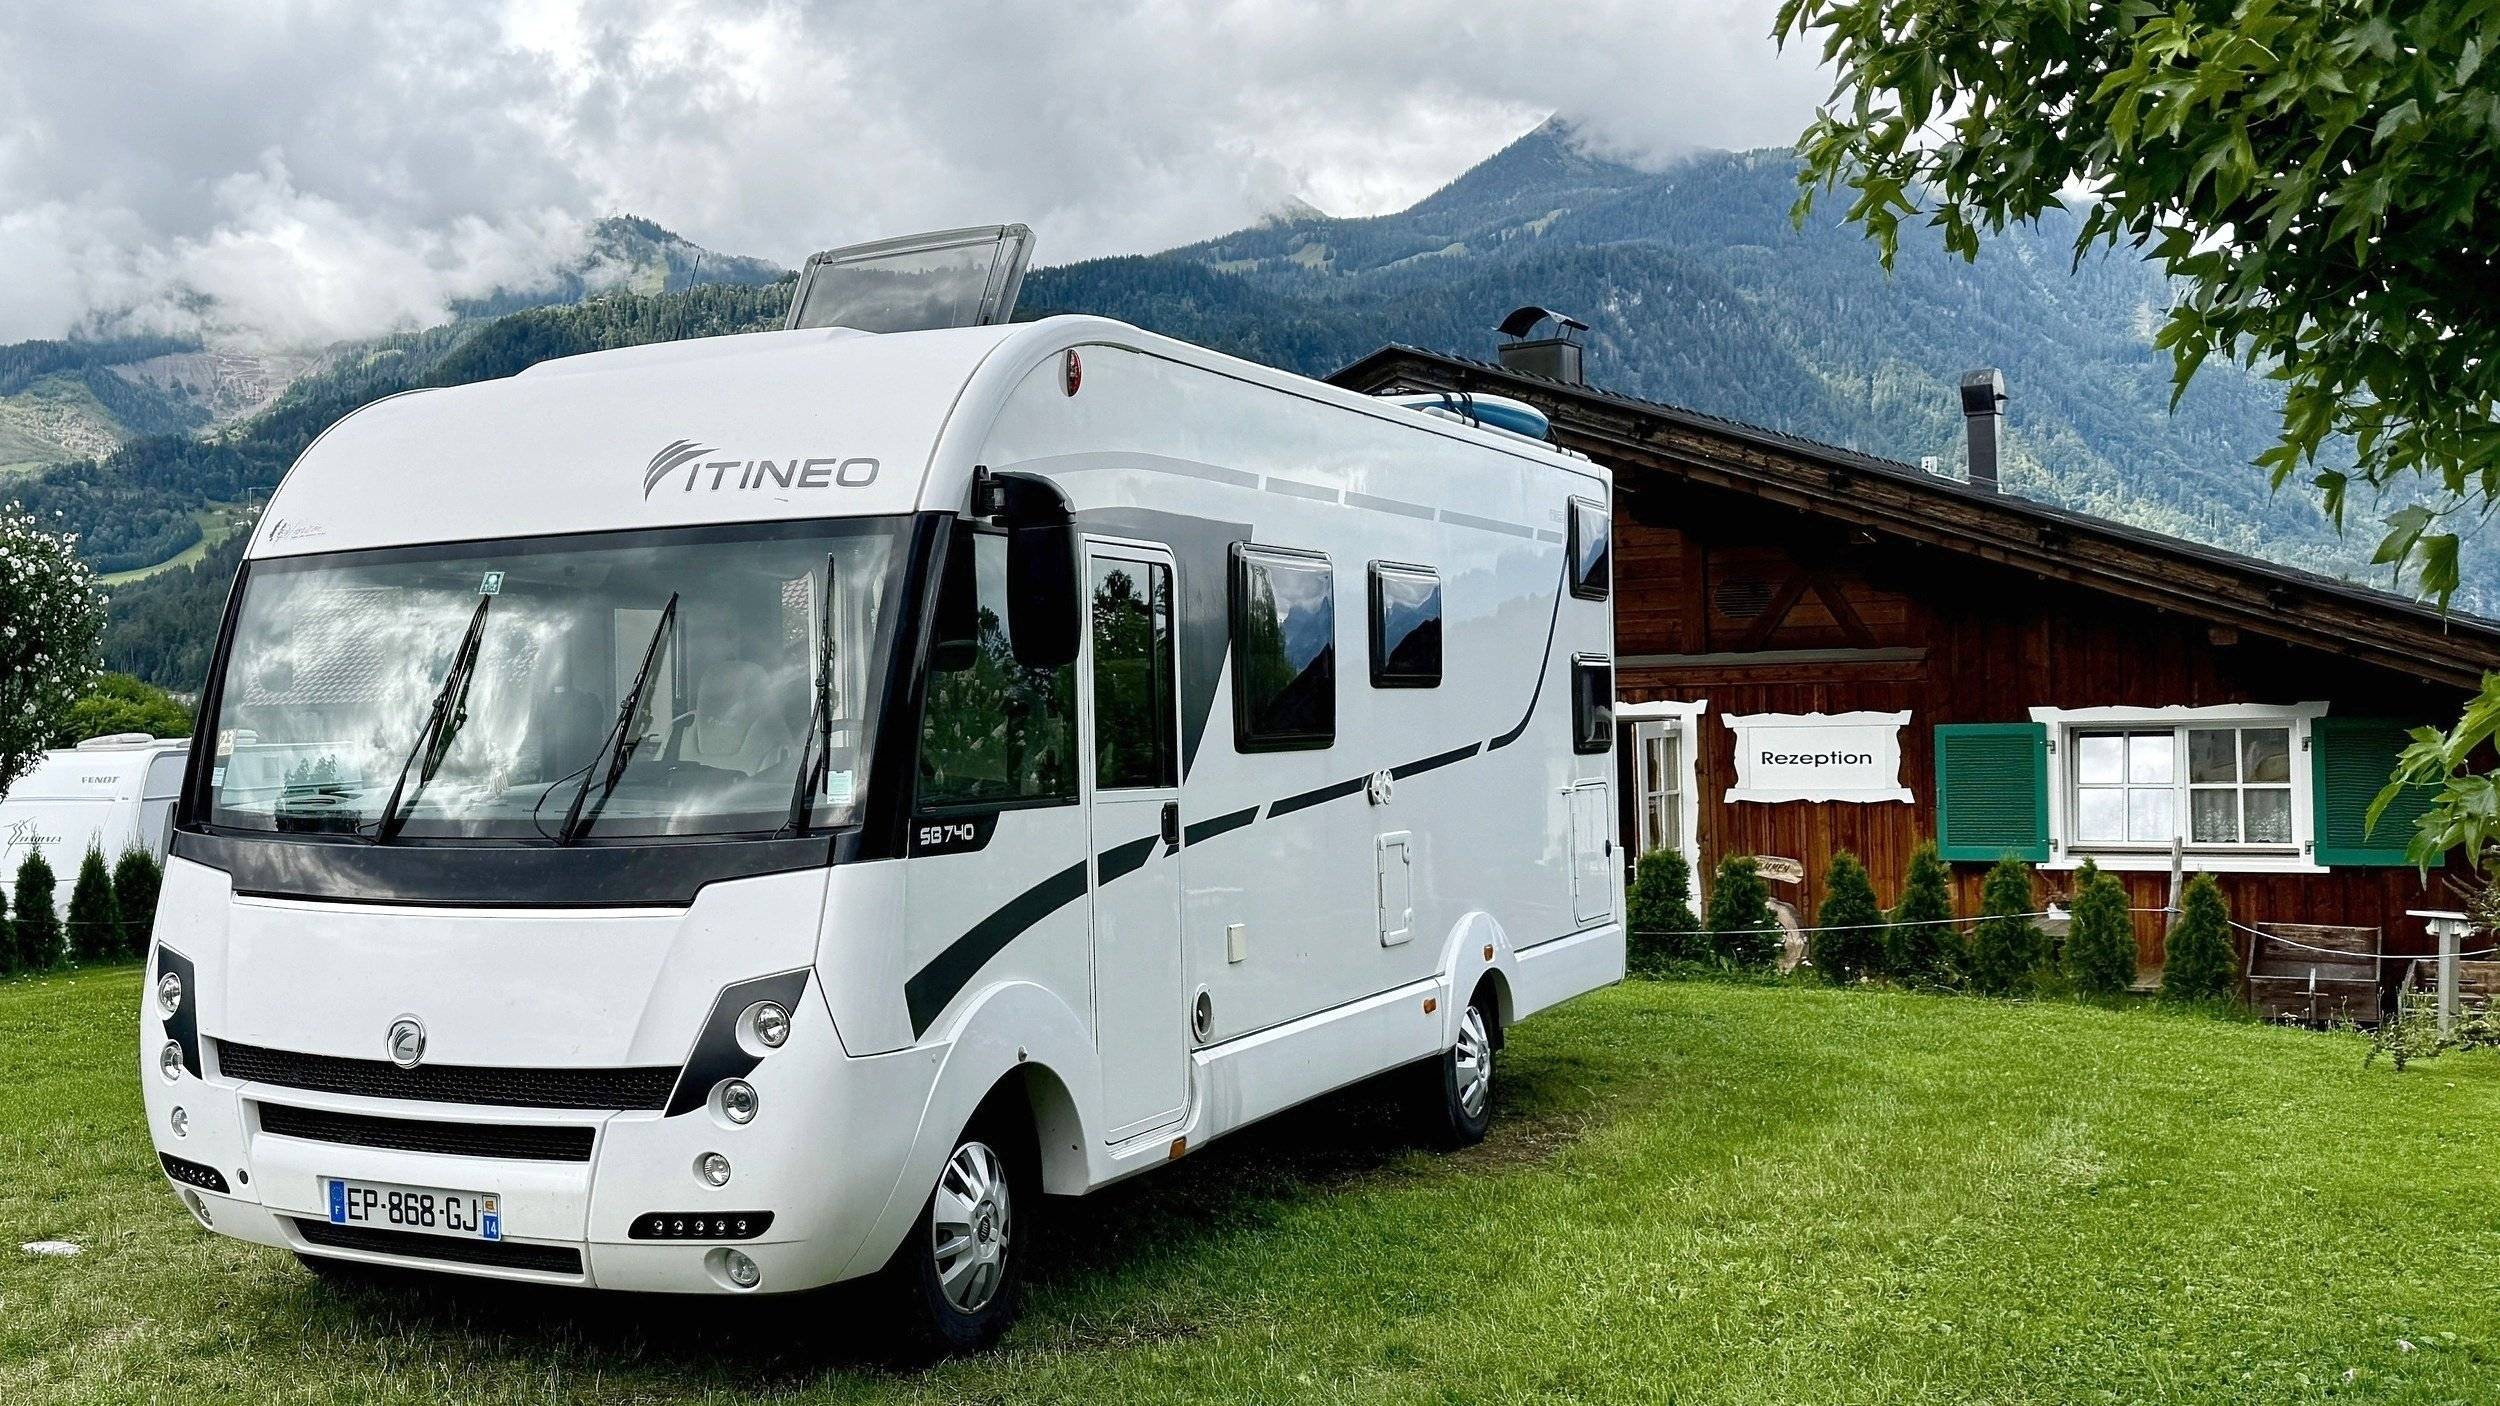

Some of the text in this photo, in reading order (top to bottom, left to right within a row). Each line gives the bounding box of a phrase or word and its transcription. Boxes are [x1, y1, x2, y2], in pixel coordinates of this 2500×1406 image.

[685, 457, 880, 491] ITINEO
[1761, 751, 1872, 767] Rezeption
[920, 824, 974, 845] SB 740
[335, 1205, 340, 1215] F
[347, 1188, 478, 1231] EP-868-GJ
[486, 1221, 497, 1235] 14
